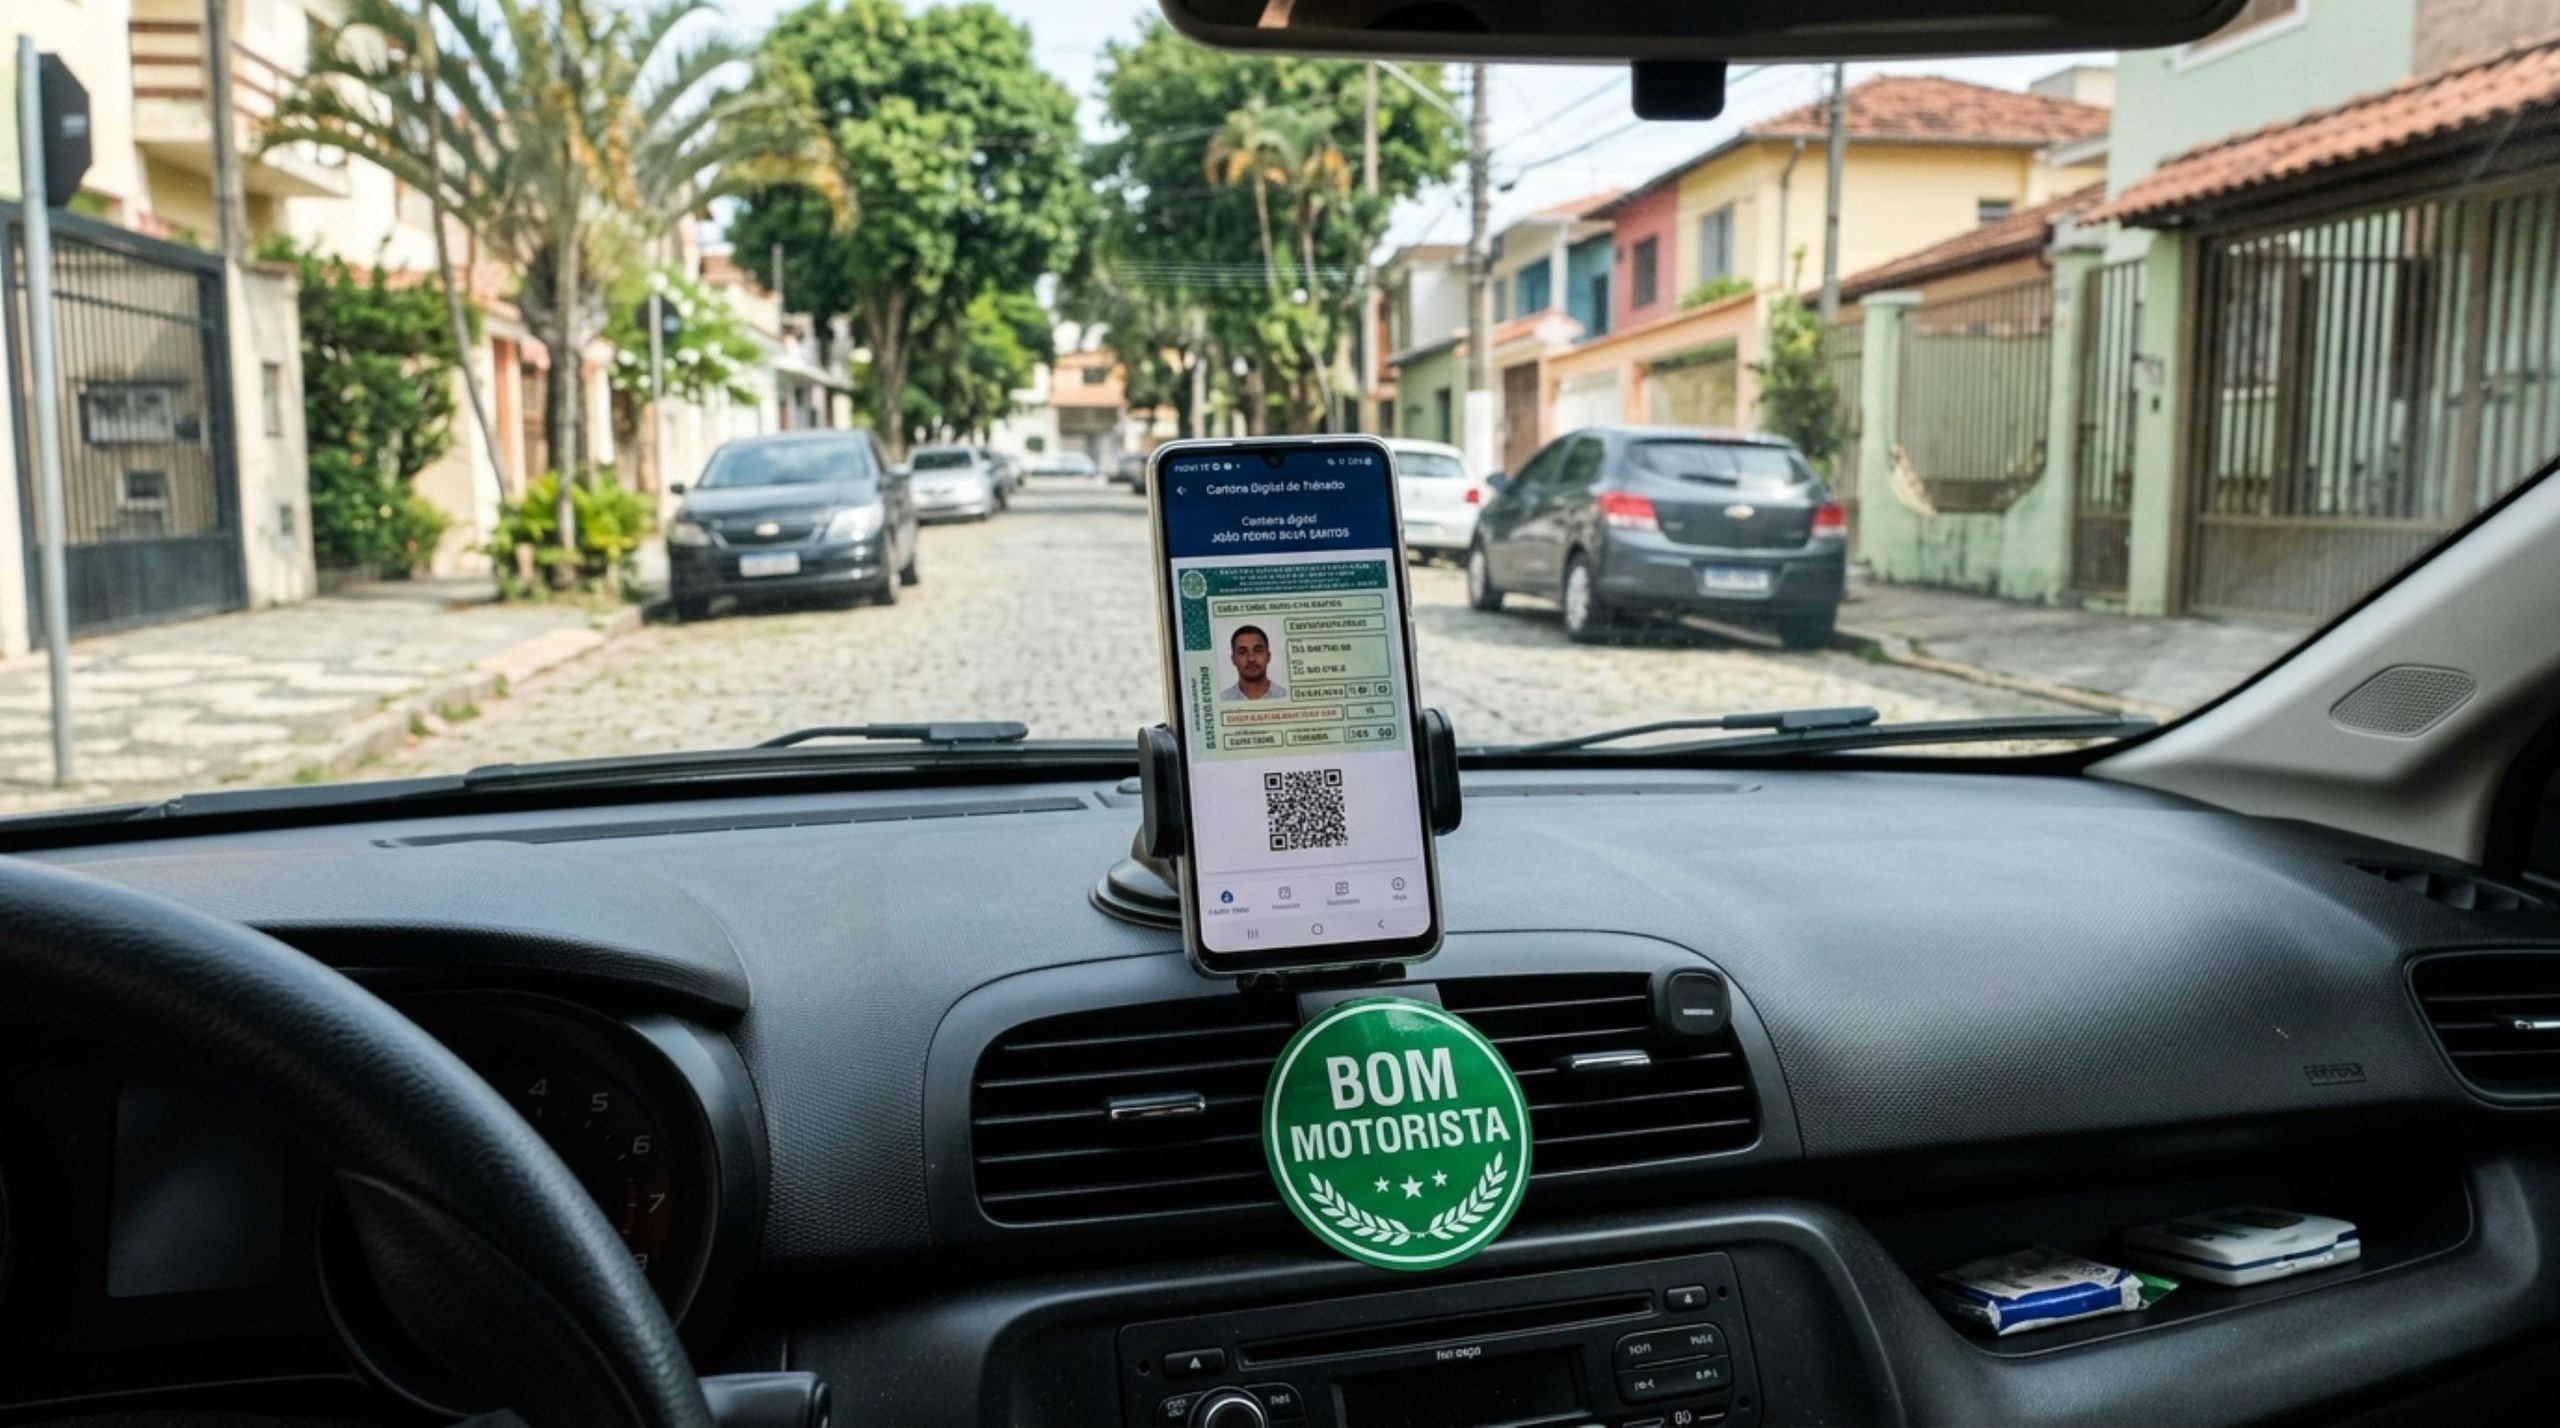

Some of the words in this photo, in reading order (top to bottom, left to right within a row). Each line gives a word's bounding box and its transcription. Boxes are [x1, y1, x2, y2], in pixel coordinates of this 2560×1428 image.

[528, 1077, 548, 1096] 4
[1326, 1047, 1459, 1110] BOM
[591, 1092, 609, 1112] 5
[632, 1134, 651, 1155] 6
[1290, 1107, 1511, 1162] MOTORISTA
[648, 1192, 666, 1213] 7
